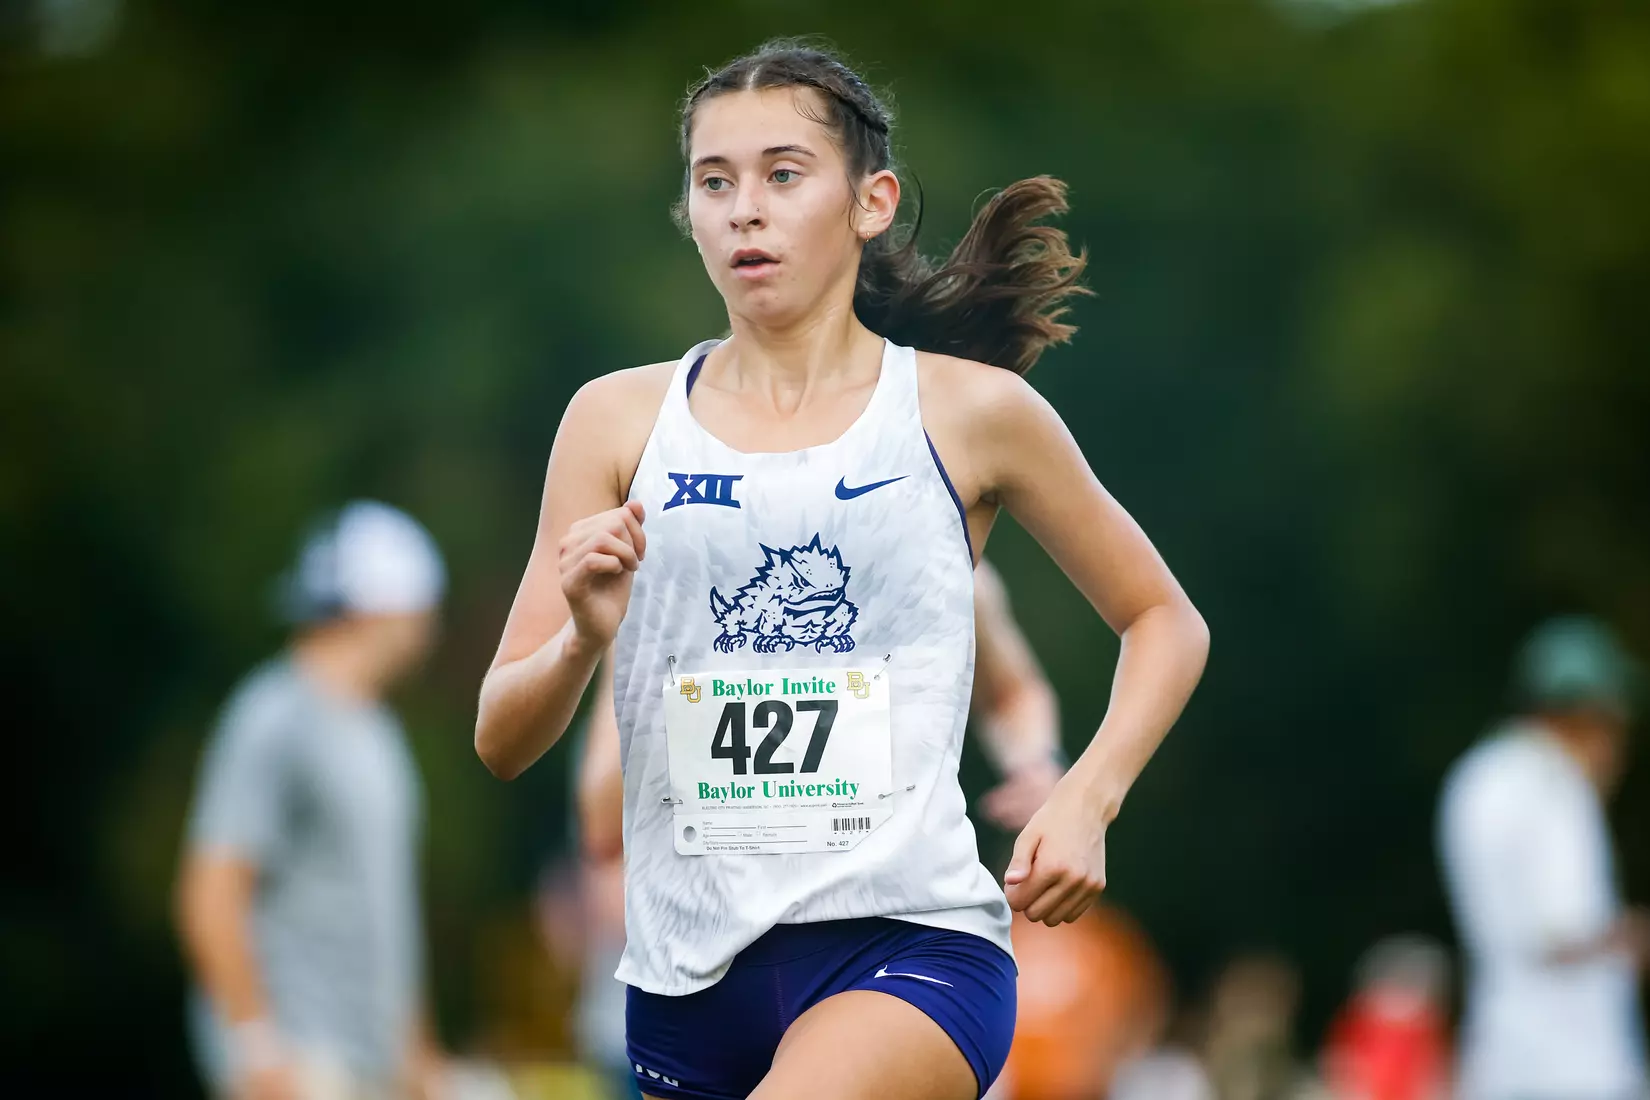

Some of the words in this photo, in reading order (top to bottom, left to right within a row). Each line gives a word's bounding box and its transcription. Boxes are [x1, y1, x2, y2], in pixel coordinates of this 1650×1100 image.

[662, 472, 744, 511] XII
[712, 678, 774, 700] Baylor
[781, 676, 836, 696] Invite
[711, 699, 839, 775] 427
[697, 781, 756, 803] Baylor
[762, 778, 860, 799] University
